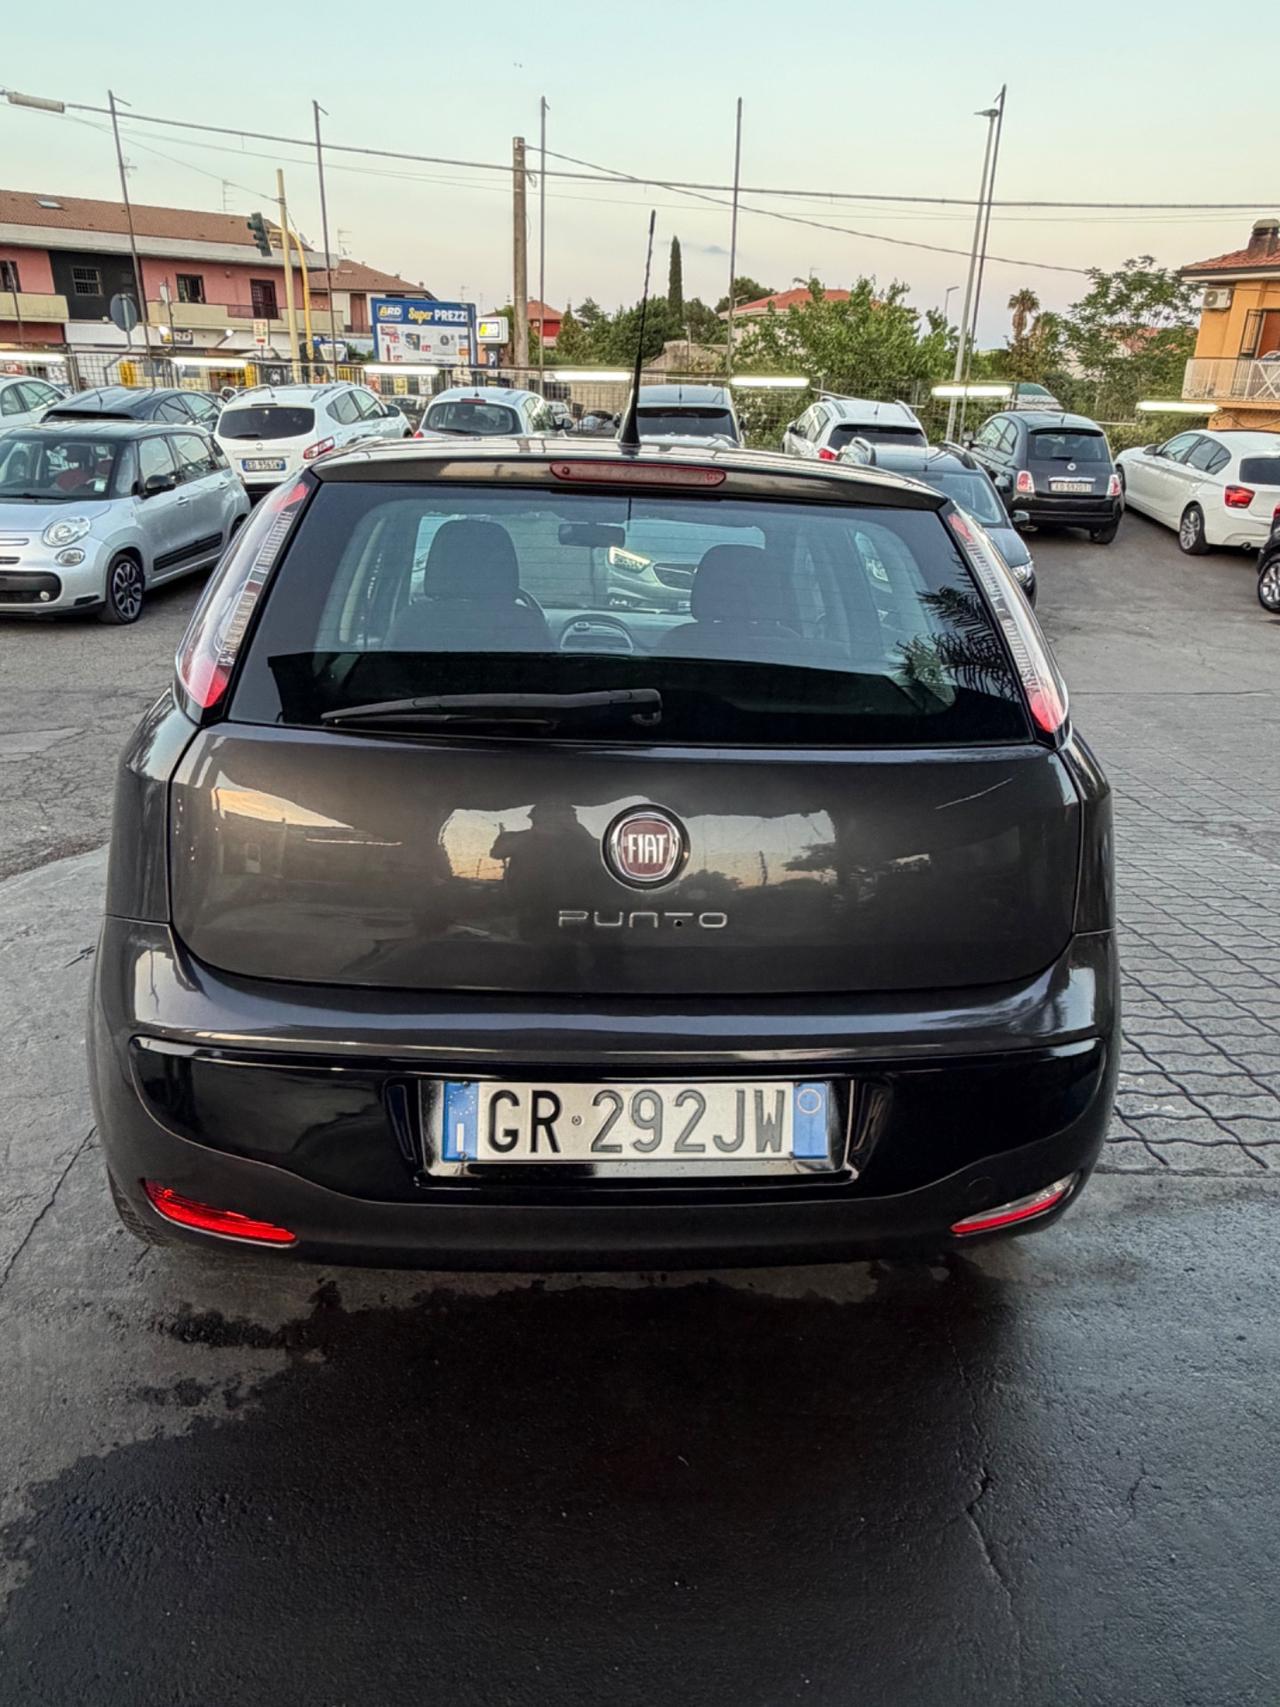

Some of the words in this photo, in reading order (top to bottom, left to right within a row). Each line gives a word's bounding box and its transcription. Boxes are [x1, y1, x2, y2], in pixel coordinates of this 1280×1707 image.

[408, 307, 433, 323] Super
[627, 834, 668, 864] FIAT
[558, 910, 728, 928] PUNTO
[487, 1089, 562, 1154] GR
[590, 1089, 786, 1154] 292JW
